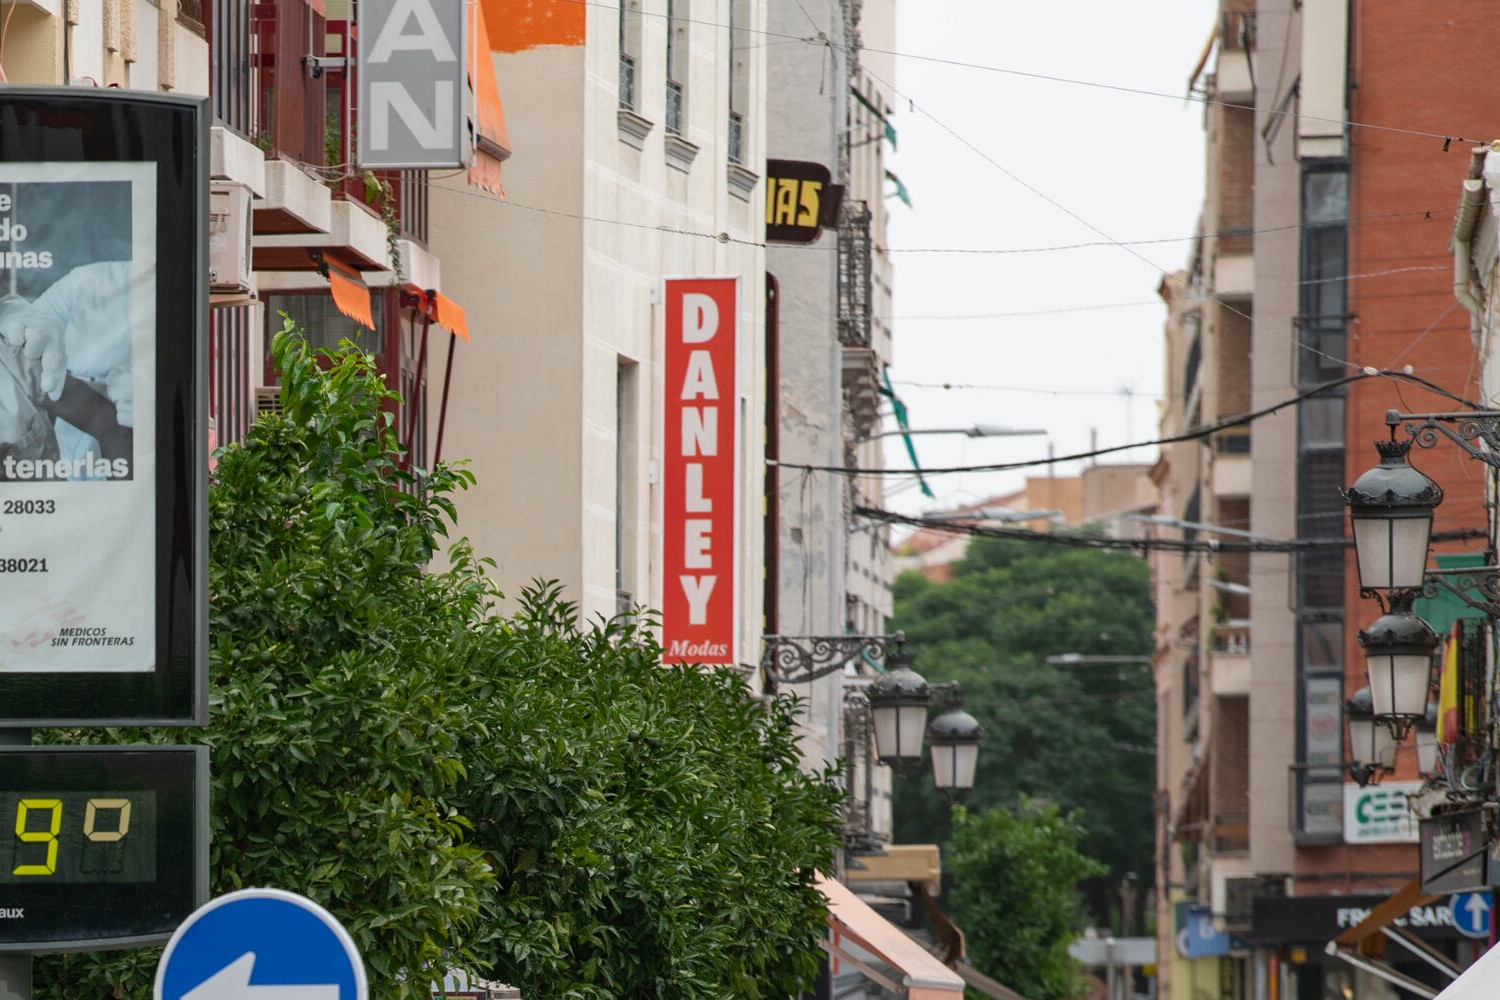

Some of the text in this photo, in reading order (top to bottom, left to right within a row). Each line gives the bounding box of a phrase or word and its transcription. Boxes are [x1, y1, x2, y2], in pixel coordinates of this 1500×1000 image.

[366, 0, 457, 150] AN
[3, 451, 129, 479] tenerlas
[680, 292, 719, 625] DANLEY
[4, 500, 55, 515] 28033
[60, 628, 107, 637] MEDICOS
[51, 636, 134, 647] SIN FRONTERAS
[668, 640, 728, 657] Modas
